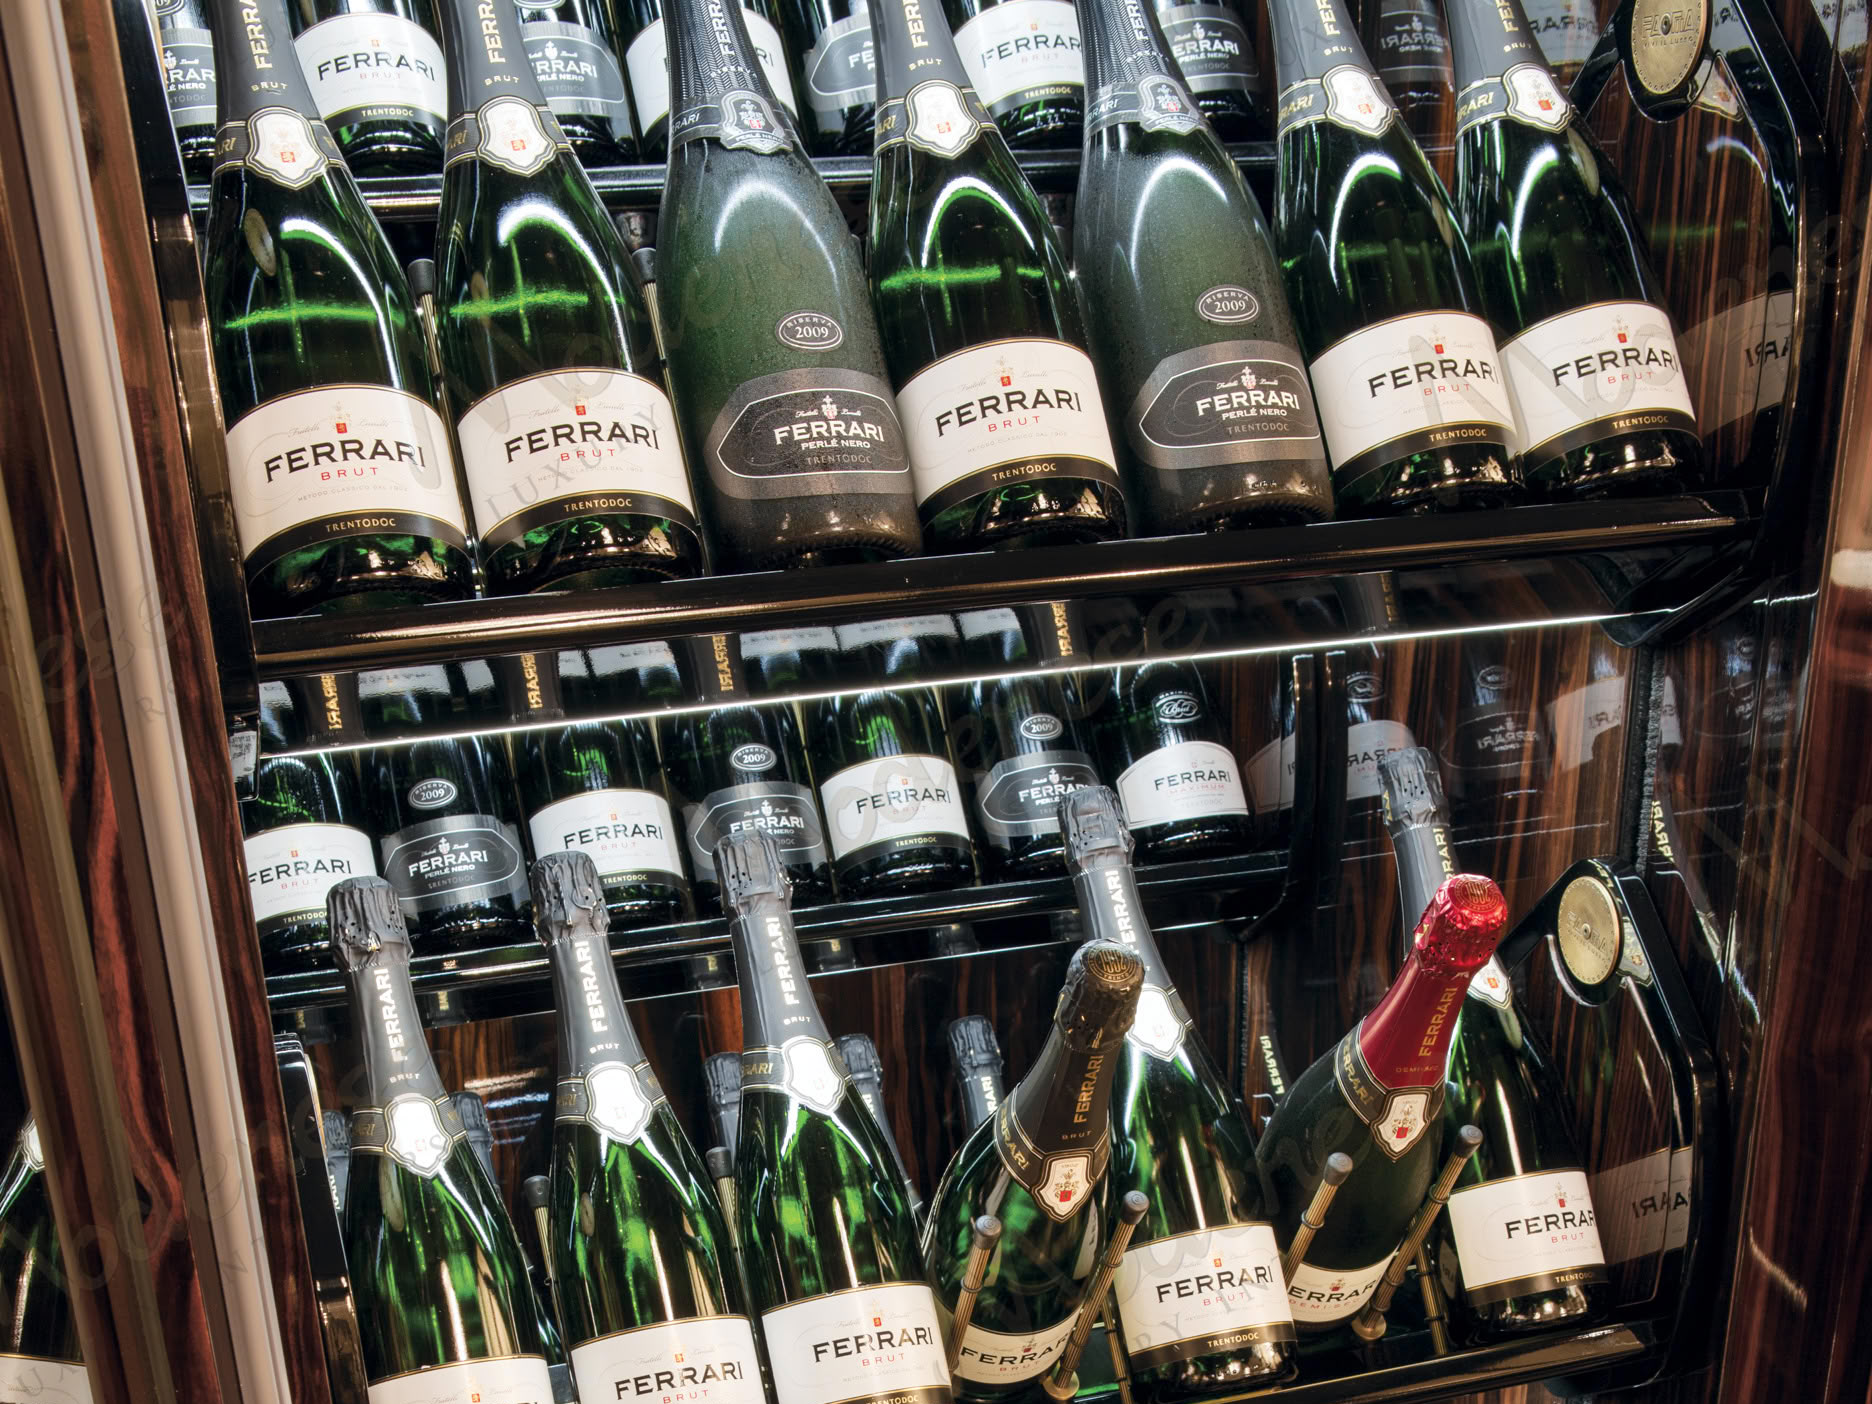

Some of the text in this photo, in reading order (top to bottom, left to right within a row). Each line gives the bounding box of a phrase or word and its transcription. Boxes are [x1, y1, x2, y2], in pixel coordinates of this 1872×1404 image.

[1323, 46, 1353, 56] BRUT
[1503, 42, 1533, 52] BRUT
[317, 51, 436, 82] FERRARI
[908, 58, 943, 71] BRUT
[251, 81, 288, 92] BRUT
[484, 75, 519, 86] BRUT
[1024, 87, 1072, 99] TRENTODOC
[361, 109, 415, 119] TRENTODOC
[1206, 291, 1249, 304] RISERVA
[1214, 300, 1246, 313] 2009
[786, 317, 833, 329] RISERVA
[795, 326, 829, 339] 2009
[1551, 347, 1680, 387] FERRARI
[1367, 358, 1500, 399] FERRARI
[1607, 371, 1654, 384] BRUT
[1423, 383, 1471, 396] BRUT
[1196, 390, 1300, 417] FERRARI
[935, 388, 1082, 438] FERRARI
[1221, 407, 1288, 421] PERLÉ NERO
[988, 415, 1041, 433] BRUT
[1227, 422, 1290, 435] TRENTODOC
[1612, 414, 1669, 430] TRENTODOC
[773, 419, 885, 446] FERRARI
[1429, 427, 1488, 442] TRENTODOC
[503, 420, 661, 464] FERRARI
[801, 438, 871, 451] PERLÉ NERO
[263, 438, 427, 484] FERRARI
[560, 448, 616, 462] BRUT
[806, 454, 873, 466] TRENTODOC
[320, 466, 379, 481] BRUT
[991, 462, 1057, 481] TRENTODOC
[563, 497, 633, 513] TRENTODOC
[325, 517, 397, 533] TRENTODOC
[1030, 722, 1054, 734] 2009
[741, 753, 767, 765] 2009
[1154, 769, 1232, 791] FERRARI
[420, 789, 446, 801] 2009
[857, 788, 951, 814] FERRARI
[563, 823, 664, 849] FERRARI
[896, 836, 938, 847] TRENTODOC
[408, 850, 489, 877] FERRARI
[424, 864, 476, 880] PERLÉ NERO
[603, 873, 648, 885] TRENTODOC
[283, 911, 328, 923] TRENTODO
[1105, 870, 1139, 954] ERRARI
[765, 916, 800, 1005] FERRARI
[575, 940, 608, 1033] FERRARI
[374, 968, 409, 1063] FERRARI
[783, 1015, 811, 1026] BRUT
[1418, 987, 1458, 1058] FERRARI
[589, 1042, 620, 1054] BRUT
[389, 1072, 420, 1083] BRUT
[1073, 1055, 1104, 1124] FERRARI
[1061, 1130, 1093, 1140] BRUT
[1551, 1232, 1586, 1244] BRUT
[1155, 1265, 1274, 1304] FERRARI
[1202, 1291, 1246, 1306] BRUT
[812, 1326, 934, 1363] FERRARI
[1207, 1331, 1260, 1348] TRENTODOC
[862, 1352, 905, 1367] BRUT
[614, 1360, 744, 1401] FERRARI
[662, 1389, 709, 1404] BRUT
